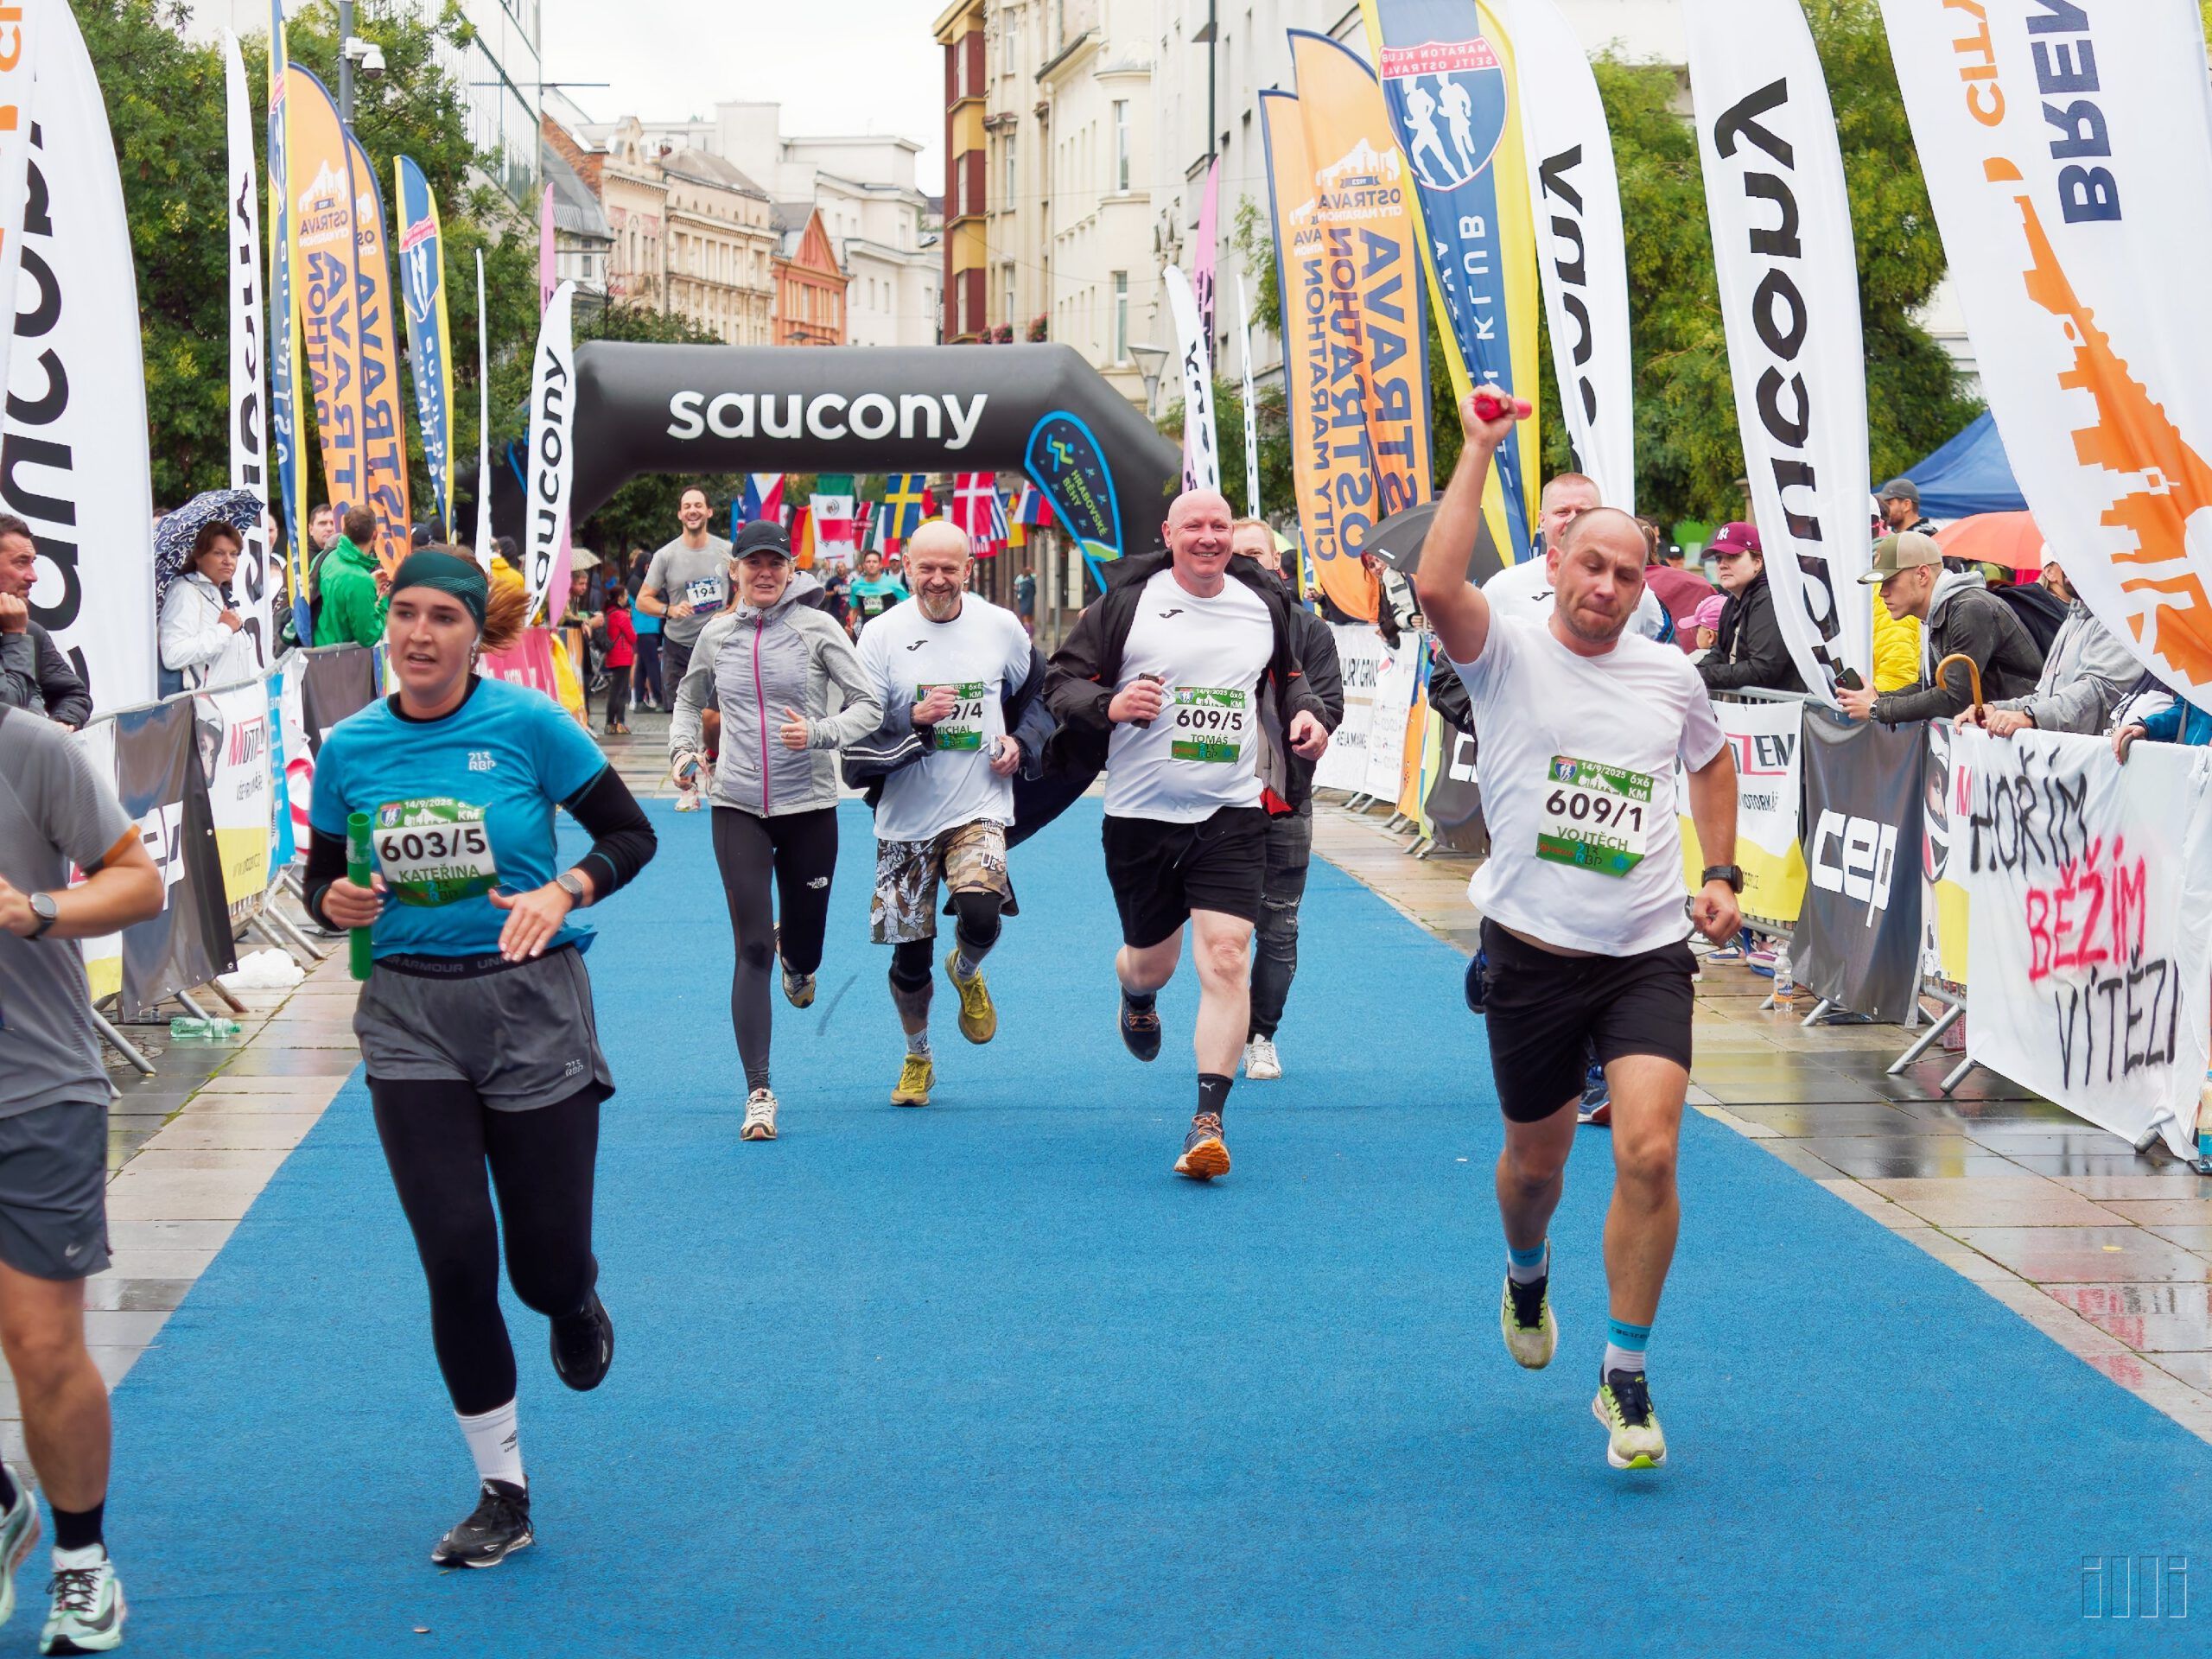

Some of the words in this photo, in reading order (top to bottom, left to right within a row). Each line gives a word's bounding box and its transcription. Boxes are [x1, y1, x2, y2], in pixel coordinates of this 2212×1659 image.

[666, 391, 988, 449] saucony
[1071, 469, 1109, 537] HRABOVSKÉ
[693, 586, 715, 598] 194
[1176, 709, 1243, 731] 609/5
[934, 725, 972, 735] MICHAL
[1191, 734, 1229, 745] TOMÁŠ
[1581, 762, 1626, 779] 14/9/2025
[1630, 774, 1649, 787] 6x6
[1628, 787, 1647, 801] KM
[404, 798, 453, 809] 14/9/2025
[1546, 789, 1642, 832] 609/1
[457, 808, 481, 821] KM
[1969, 746, 2088, 881] HOŘÍM
[380, 828, 486, 862] 603/5
[1556, 825, 1629, 852] VOJTĚCH
[398, 863, 480, 883] KATEŘINA
[2026, 835, 2146, 983] BĚŽÍM
[402, 957, 465, 973] ARMOUR
